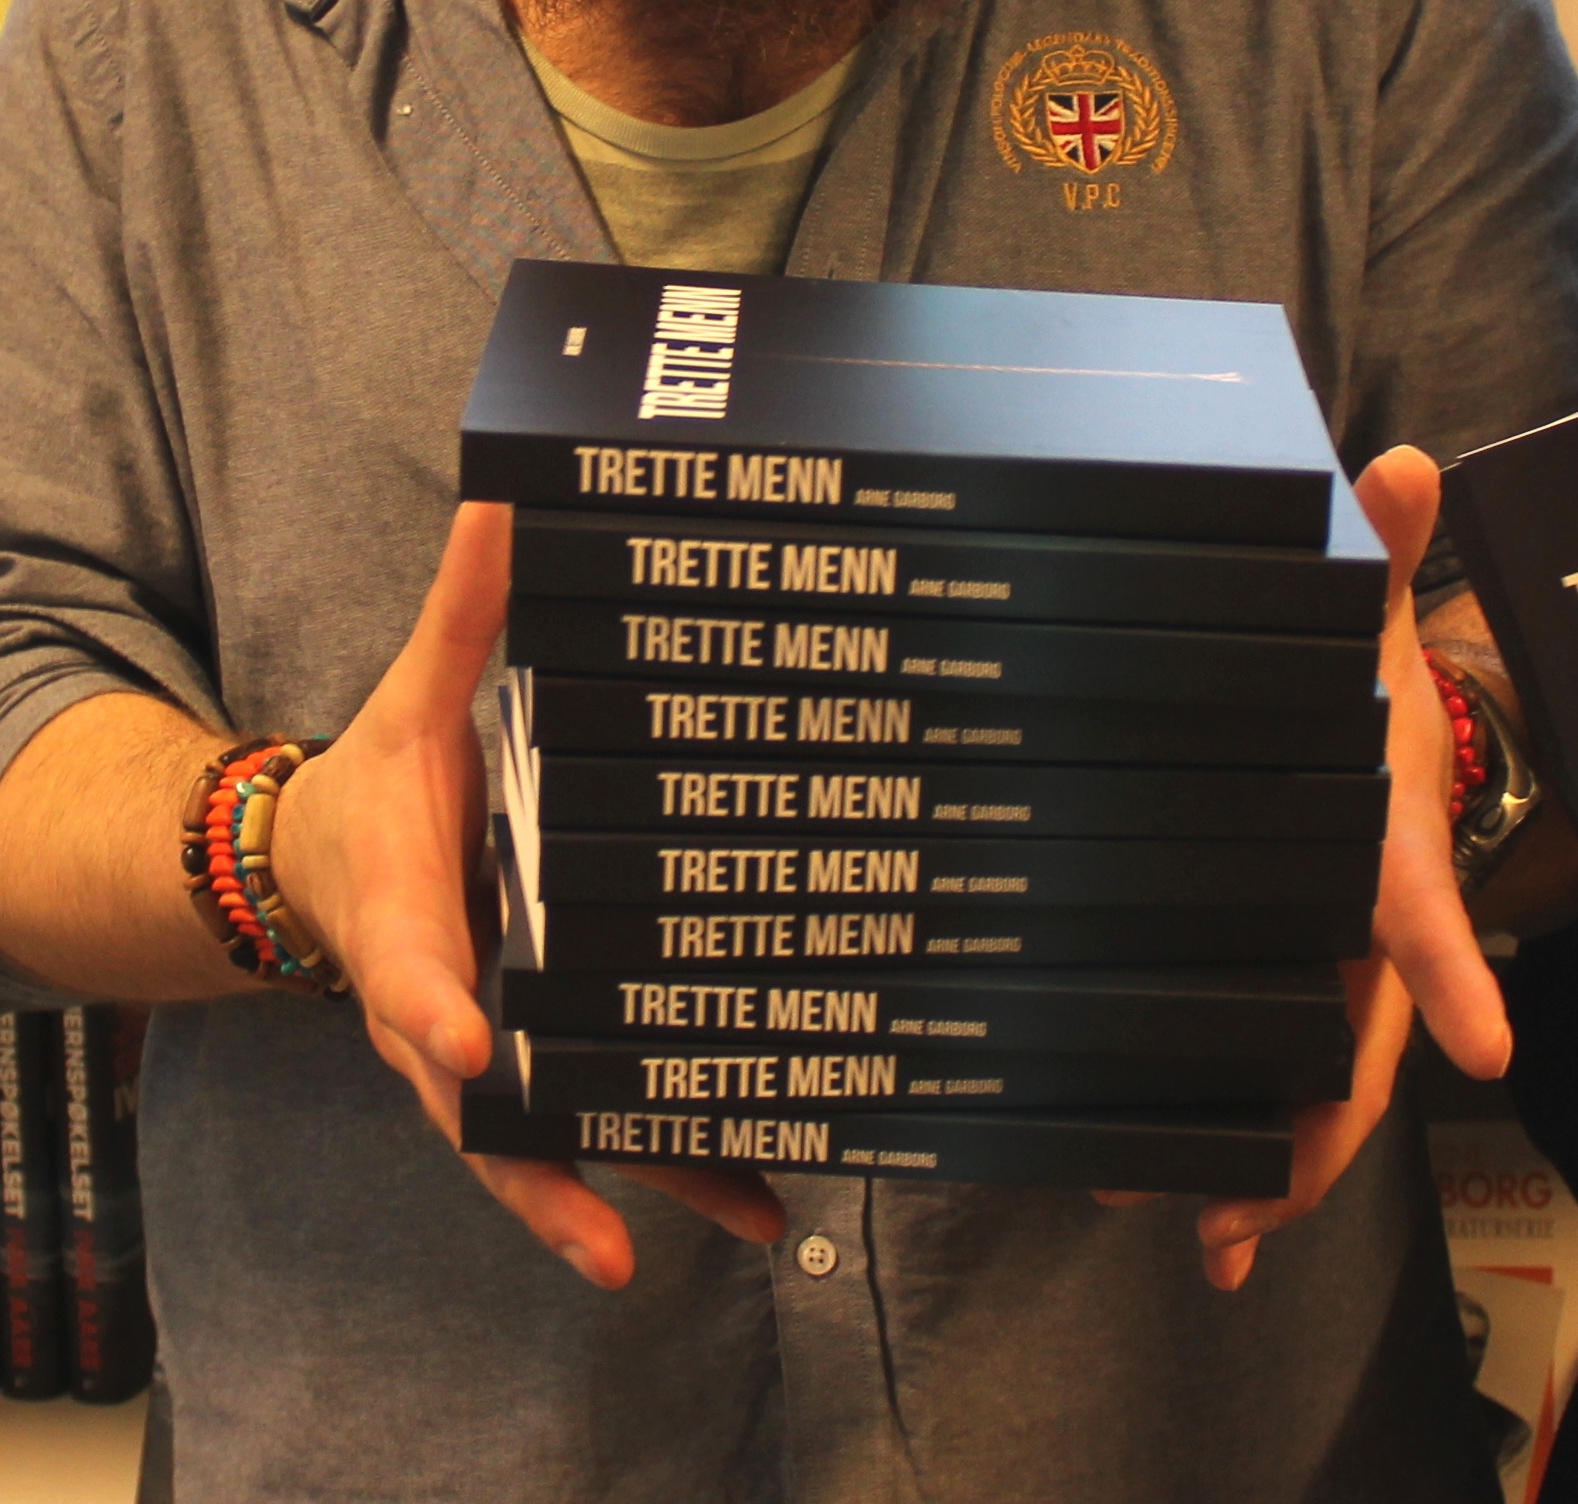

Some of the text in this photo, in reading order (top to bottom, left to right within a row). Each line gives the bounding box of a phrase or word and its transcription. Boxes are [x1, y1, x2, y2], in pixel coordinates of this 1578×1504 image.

[637, 284, 742, 419] TRETTE MENN
[574, 445, 718, 500] TRETTE
[727, 454, 843, 506] MENN
[626, 537, 774, 592] TRETTE
[780, 546, 898, 597] MENN
[621, 615, 889, 674] TRETTE MENN
[646, 693, 911, 745] TRETTE MENN
[657, 771, 799, 819] TRETTE
[807, 775, 921, 821] MENN
[657, 849, 920, 893] TRETTE MENN
[657, 913, 915, 958] TRETTE MENN
[619, 983, 878, 1034] TRETTE MENN
[641, 1055, 898, 1099] TRETTE MENN
[63, 1006, 96, 1222] ERNSPØKELSET
[577, 1111, 712, 1157] TRETTE
[720, 1119, 830, 1163] MENN
